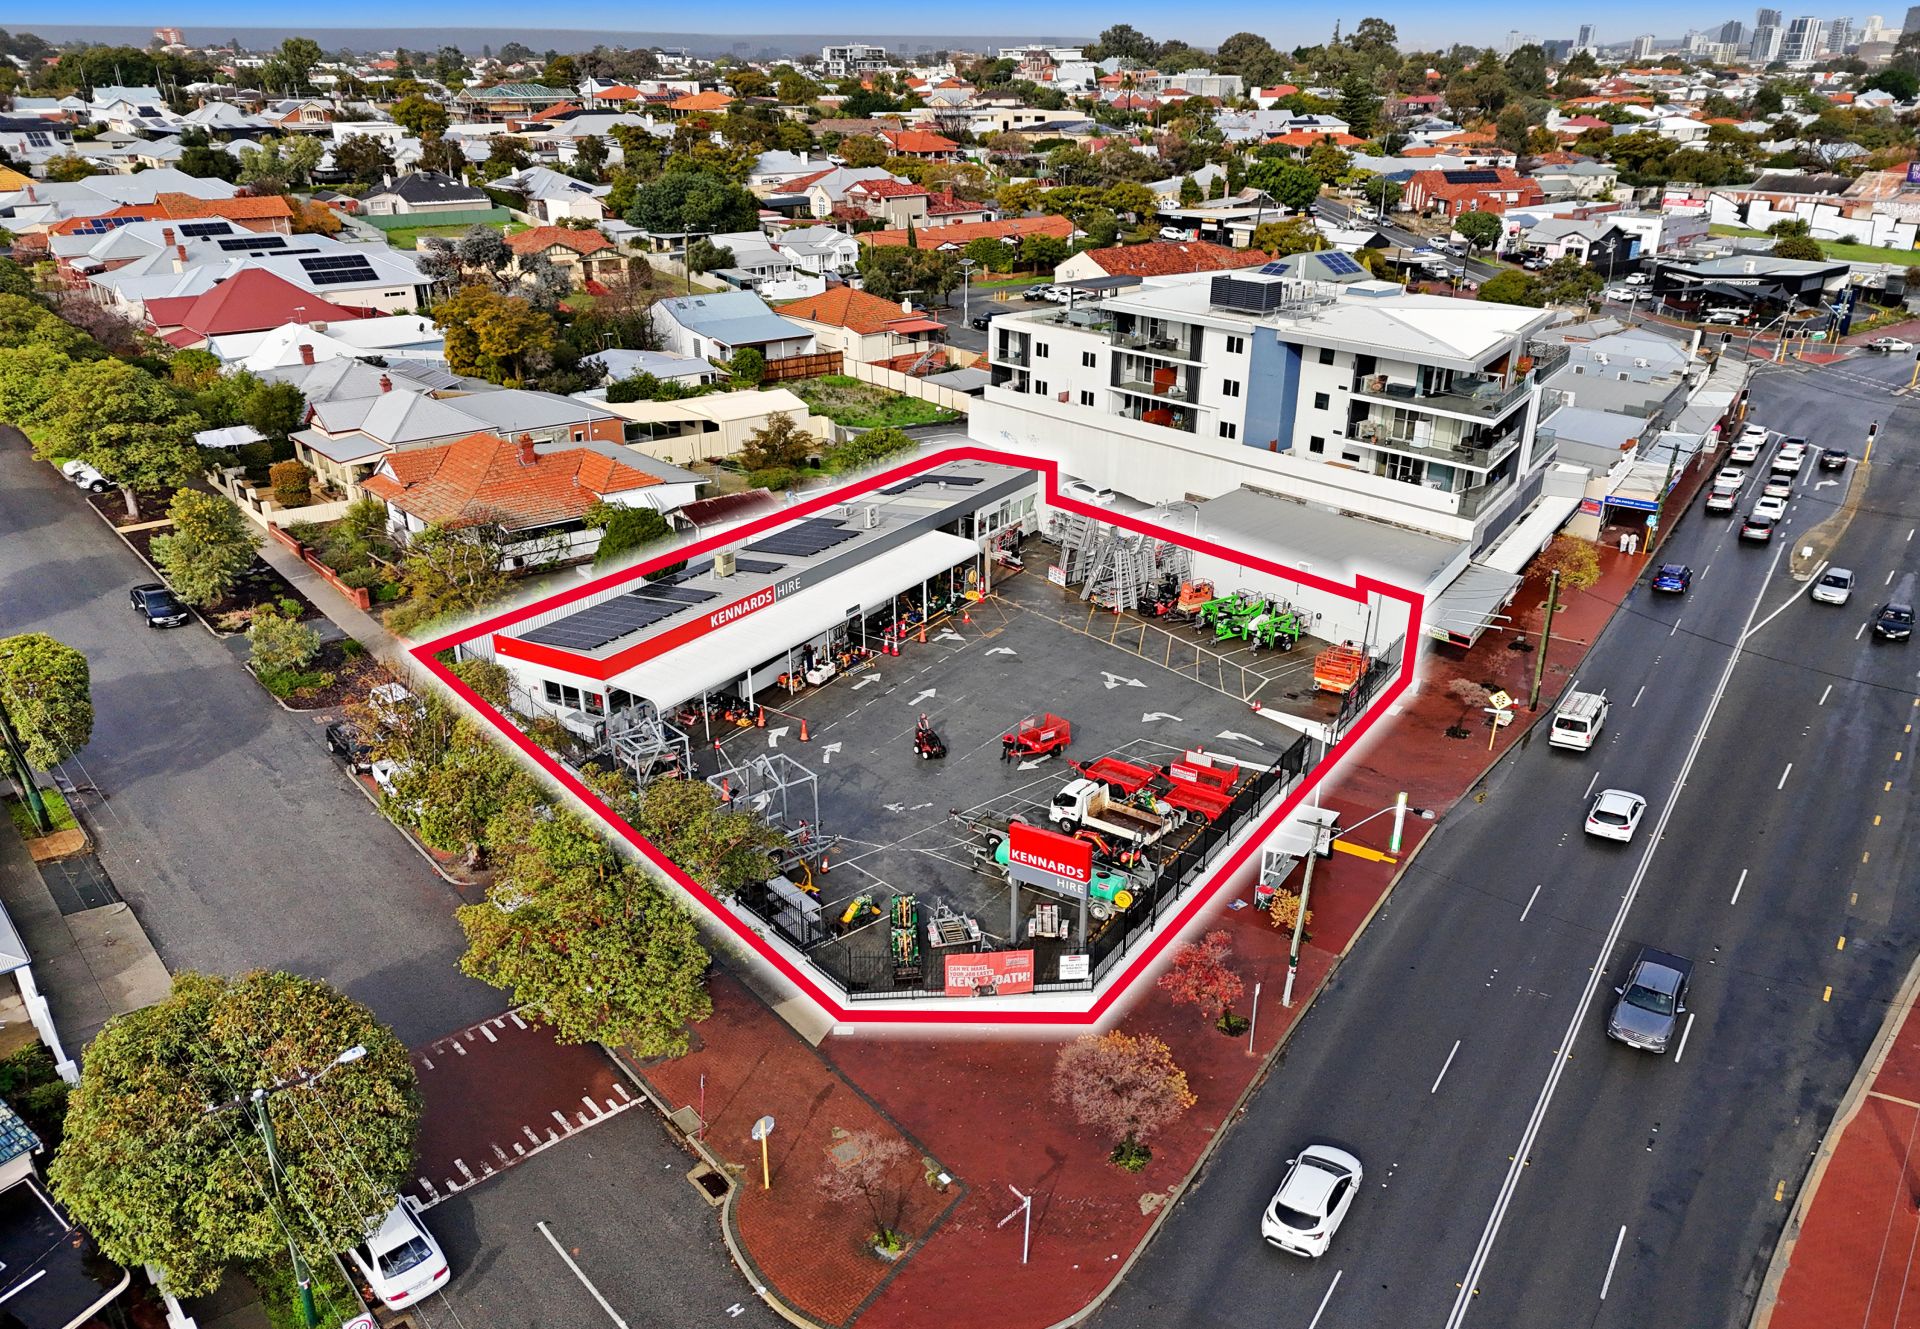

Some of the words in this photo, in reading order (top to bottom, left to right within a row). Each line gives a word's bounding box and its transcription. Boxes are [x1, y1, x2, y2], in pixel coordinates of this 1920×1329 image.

[710, 590, 773, 628] KENNARDS
[777, 577, 801, 598] HIRE
[1011, 849, 1084, 879] KENNARDS
[1056, 878, 1084, 894] HIRE
